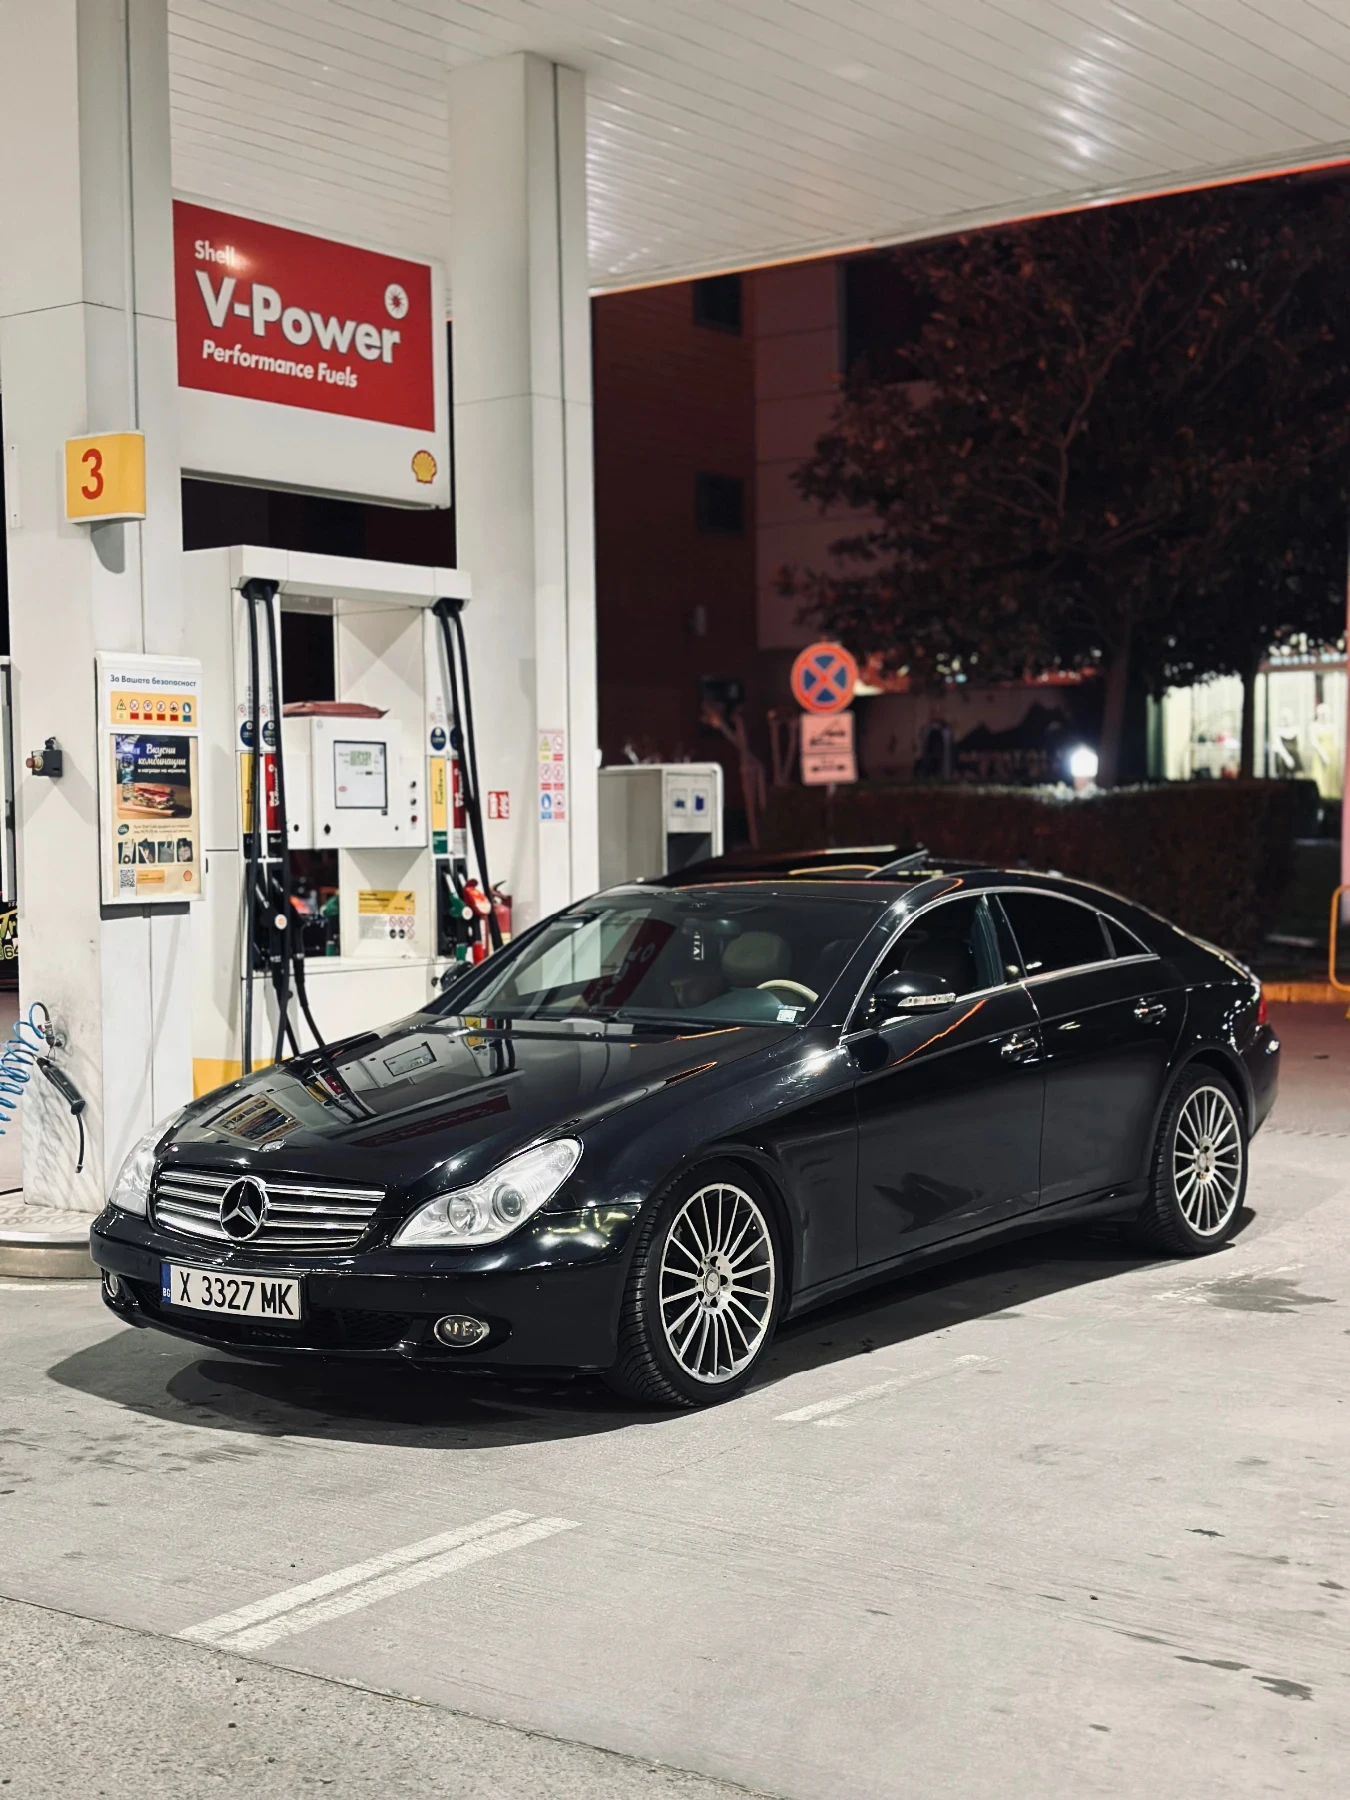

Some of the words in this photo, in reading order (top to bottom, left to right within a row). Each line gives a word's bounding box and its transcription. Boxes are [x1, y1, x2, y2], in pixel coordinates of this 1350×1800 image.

[194, 239, 237, 266] Shell
[195, 269, 401, 364] V-Power
[202, 339, 315, 380] Performance
[317, 363, 358, 389] Fuels
[81, 448, 104, 500] 3
[110, 674, 120, 683] За
[121, 675, 150, 685] Вашата
[151, 677, 197, 687] безопасност
[138, 755, 186, 768] комбинации
[146, 744, 176, 757] Вкусни
[162, 1287, 171, 1298] BG
[179, 1270, 191, 1303] X
[201, 1275, 255, 1311] 3327
[260, 1281, 294, 1316] MK
